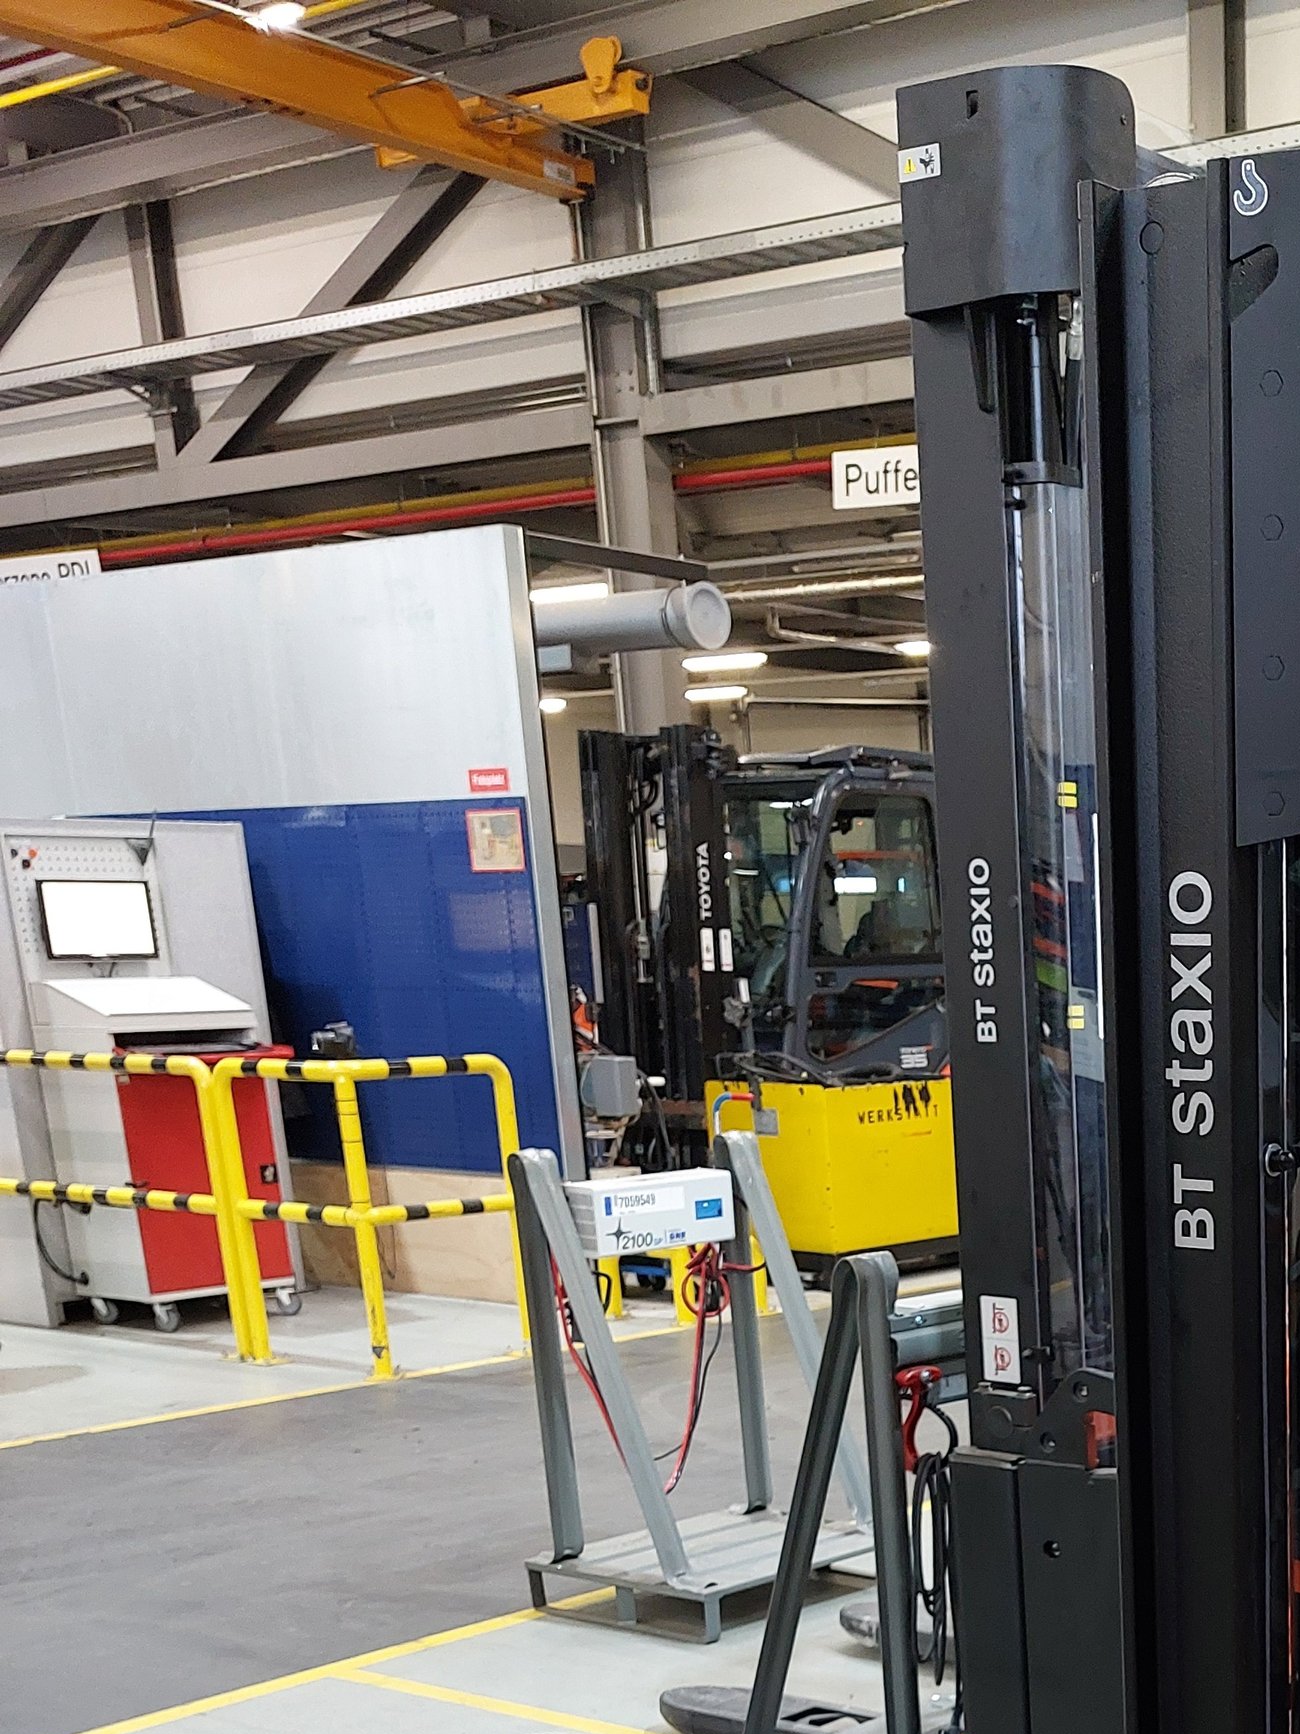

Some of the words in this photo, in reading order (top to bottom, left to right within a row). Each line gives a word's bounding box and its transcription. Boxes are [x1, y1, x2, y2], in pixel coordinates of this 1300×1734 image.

[845, 459, 918, 497] Puffe
[695, 841, 713, 921] TOYOTA
[974, 999, 998, 1043] BT
[857, 1104, 938, 1124] WERKST
[1173, 1163, 1216, 1250] BT
[622, 1231, 654, 1250] 2100
